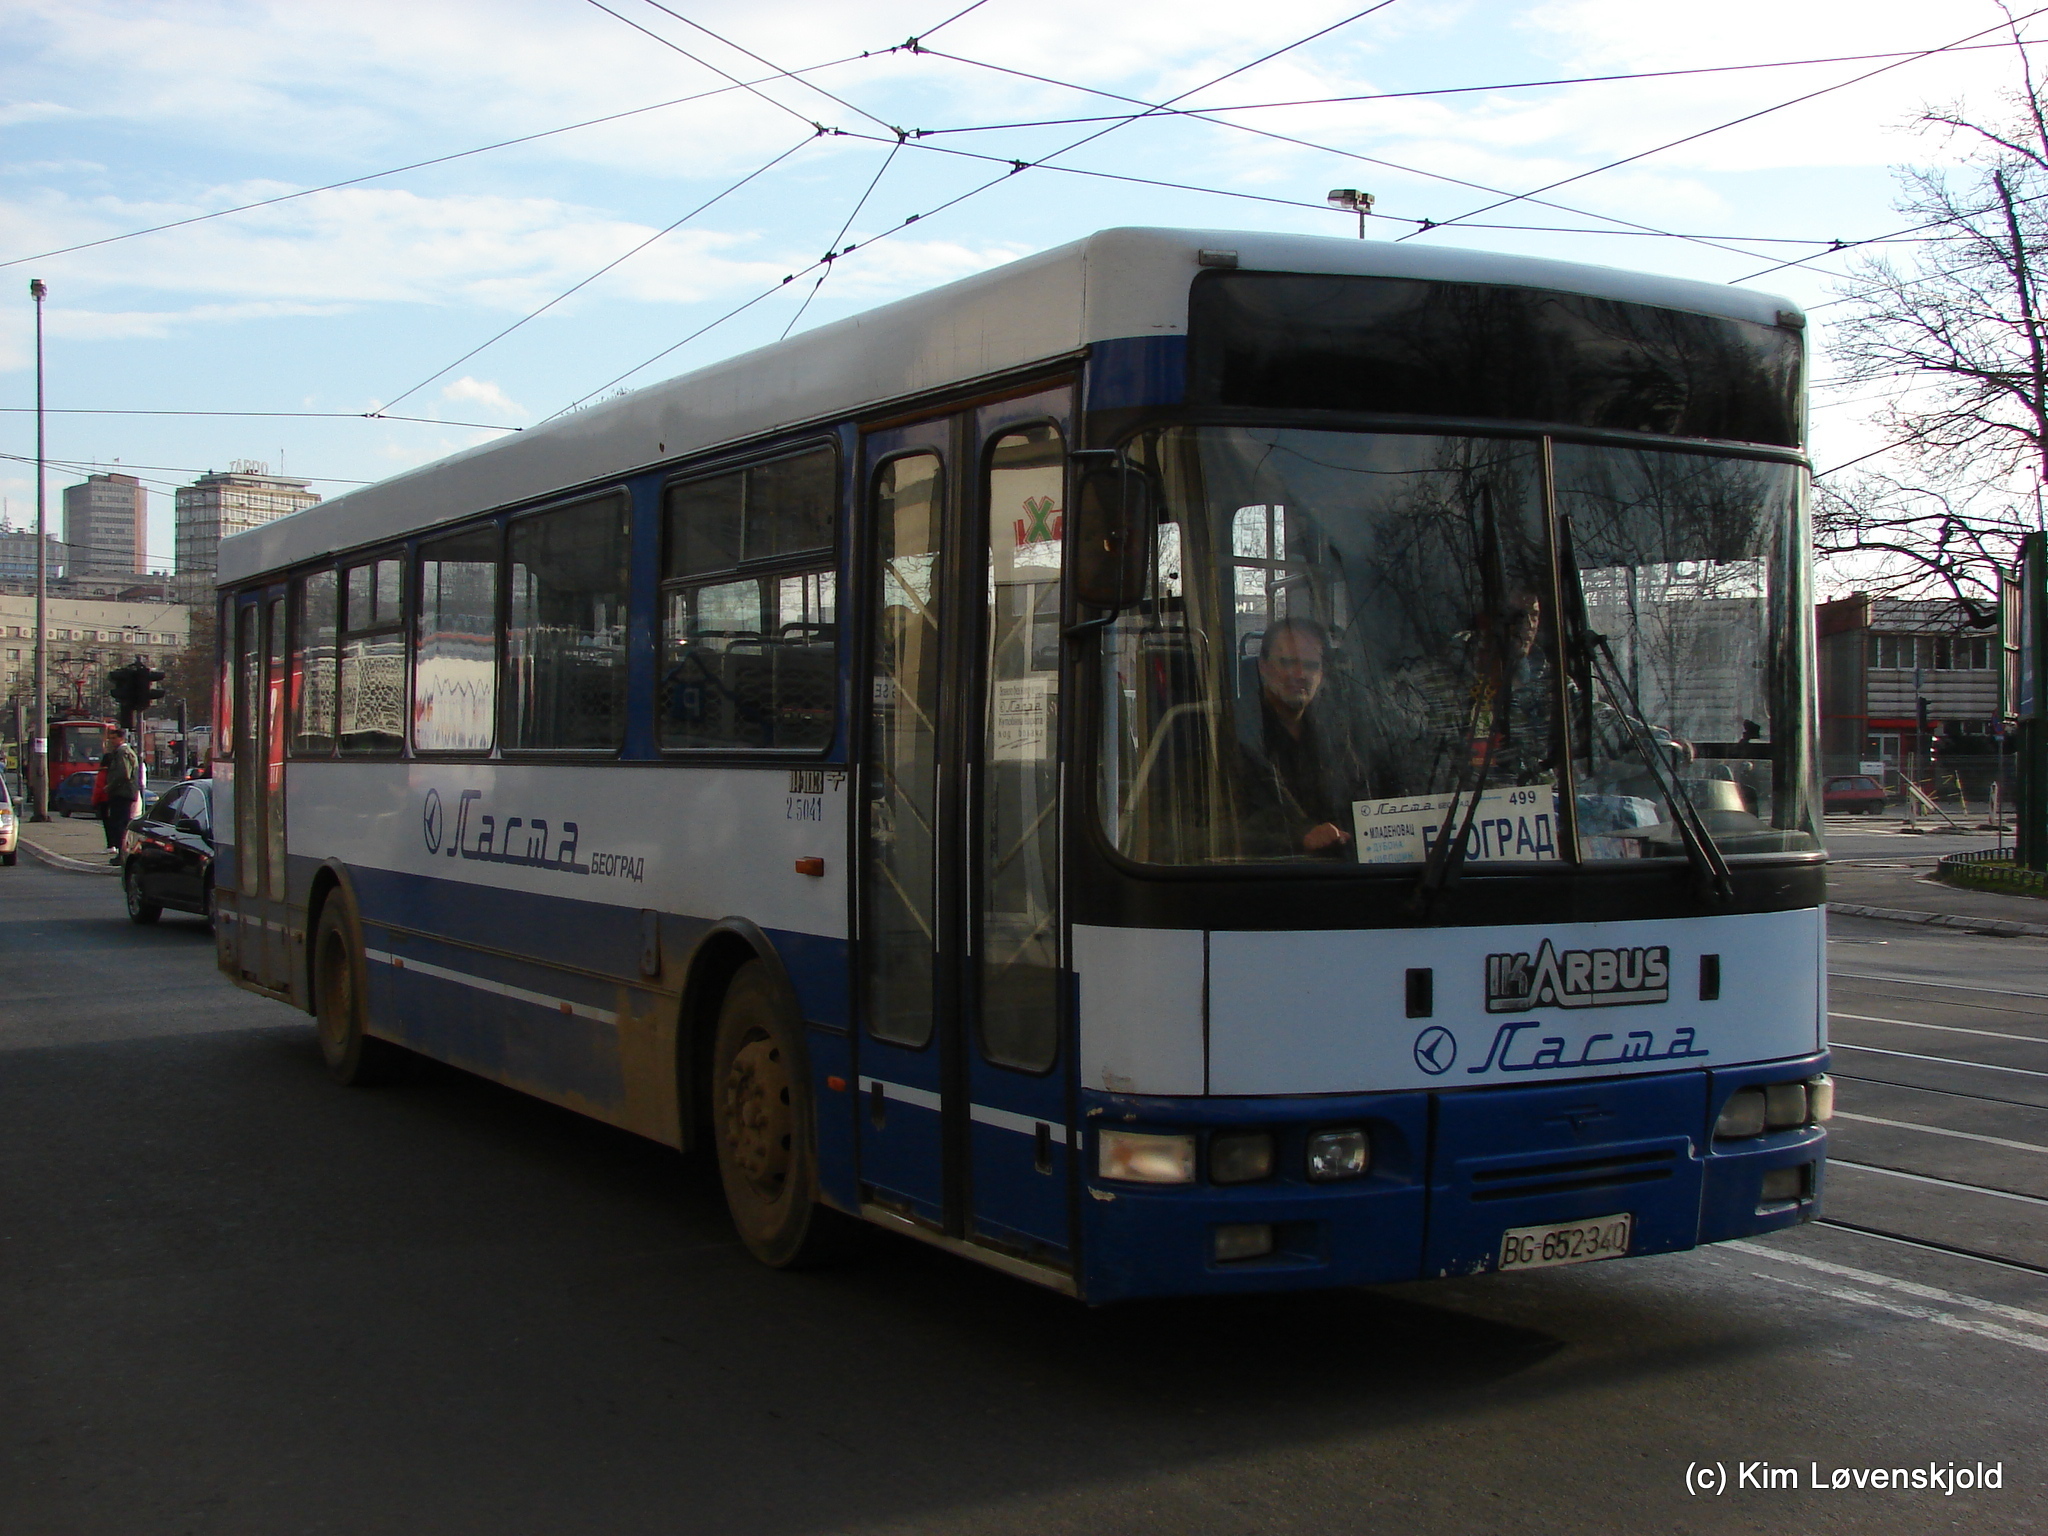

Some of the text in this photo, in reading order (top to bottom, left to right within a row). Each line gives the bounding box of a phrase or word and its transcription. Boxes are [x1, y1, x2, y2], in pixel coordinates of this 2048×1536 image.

[1509, 790, 1536, 806] 499
[1369, 823, 1415, 840] МЛАДЕНОВАЦ
[591, 852, 645, 883] БЕОГРАД
[1486, 938, 1669, 1013] IKARBUS
